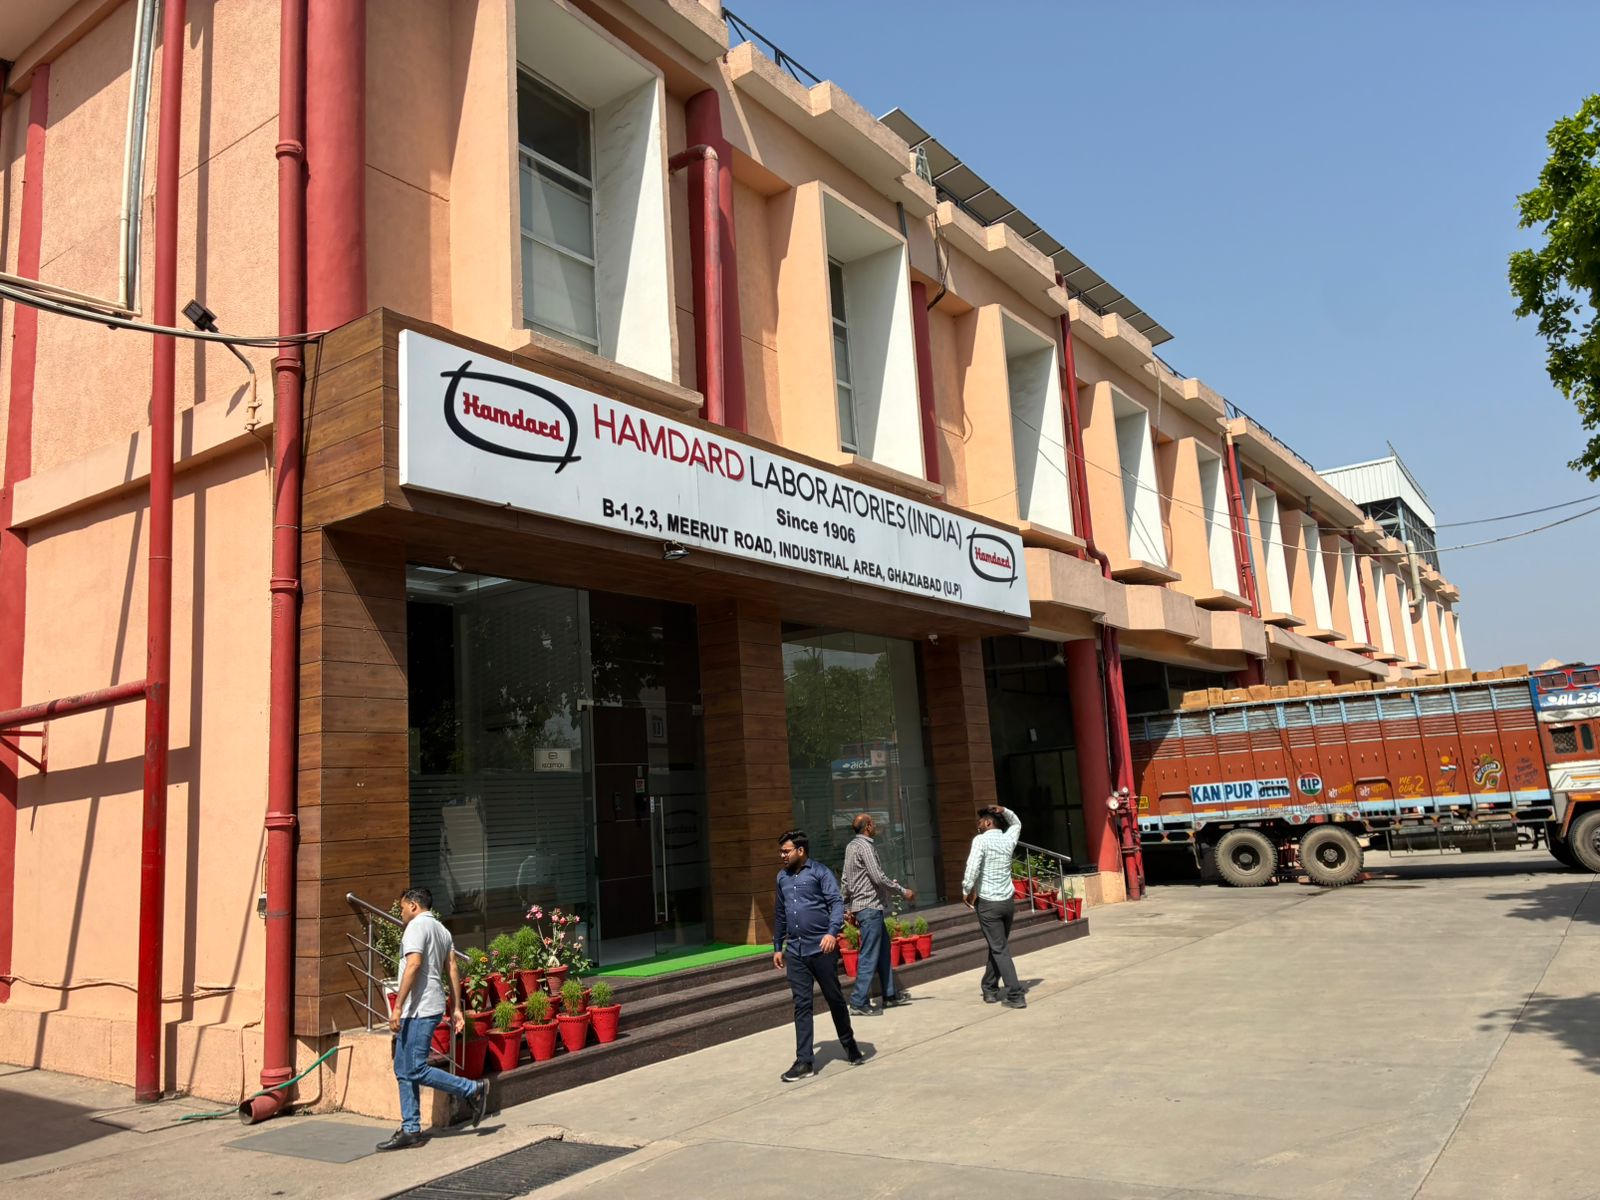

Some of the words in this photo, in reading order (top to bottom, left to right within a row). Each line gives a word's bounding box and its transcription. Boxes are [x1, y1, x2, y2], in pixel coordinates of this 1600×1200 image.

[463, 392, 565, 442] Hamdard
[593, 403, 745, 482] HAMDARD
[777, 508, 819, 534] Since
[823, 522, 856, 544] 1906
[602, 498, 663, 533] B-1,2,3,
[667, 513, 729, 545] MEERUT
[734, 530, 777, 559] ROAD,
[779, 541, 849, 573] INDUSTRIAL
[853, 559, 886, 583] AREA,
[887, 567, 942, 593] GHAZIABAD
[943, 580, 963, 600] (U.P)
[974, 547, 1012, 570] Hamdard
[1299, 777, 1320, 790] AIP
[1414, 774, 1425, 793] 2
